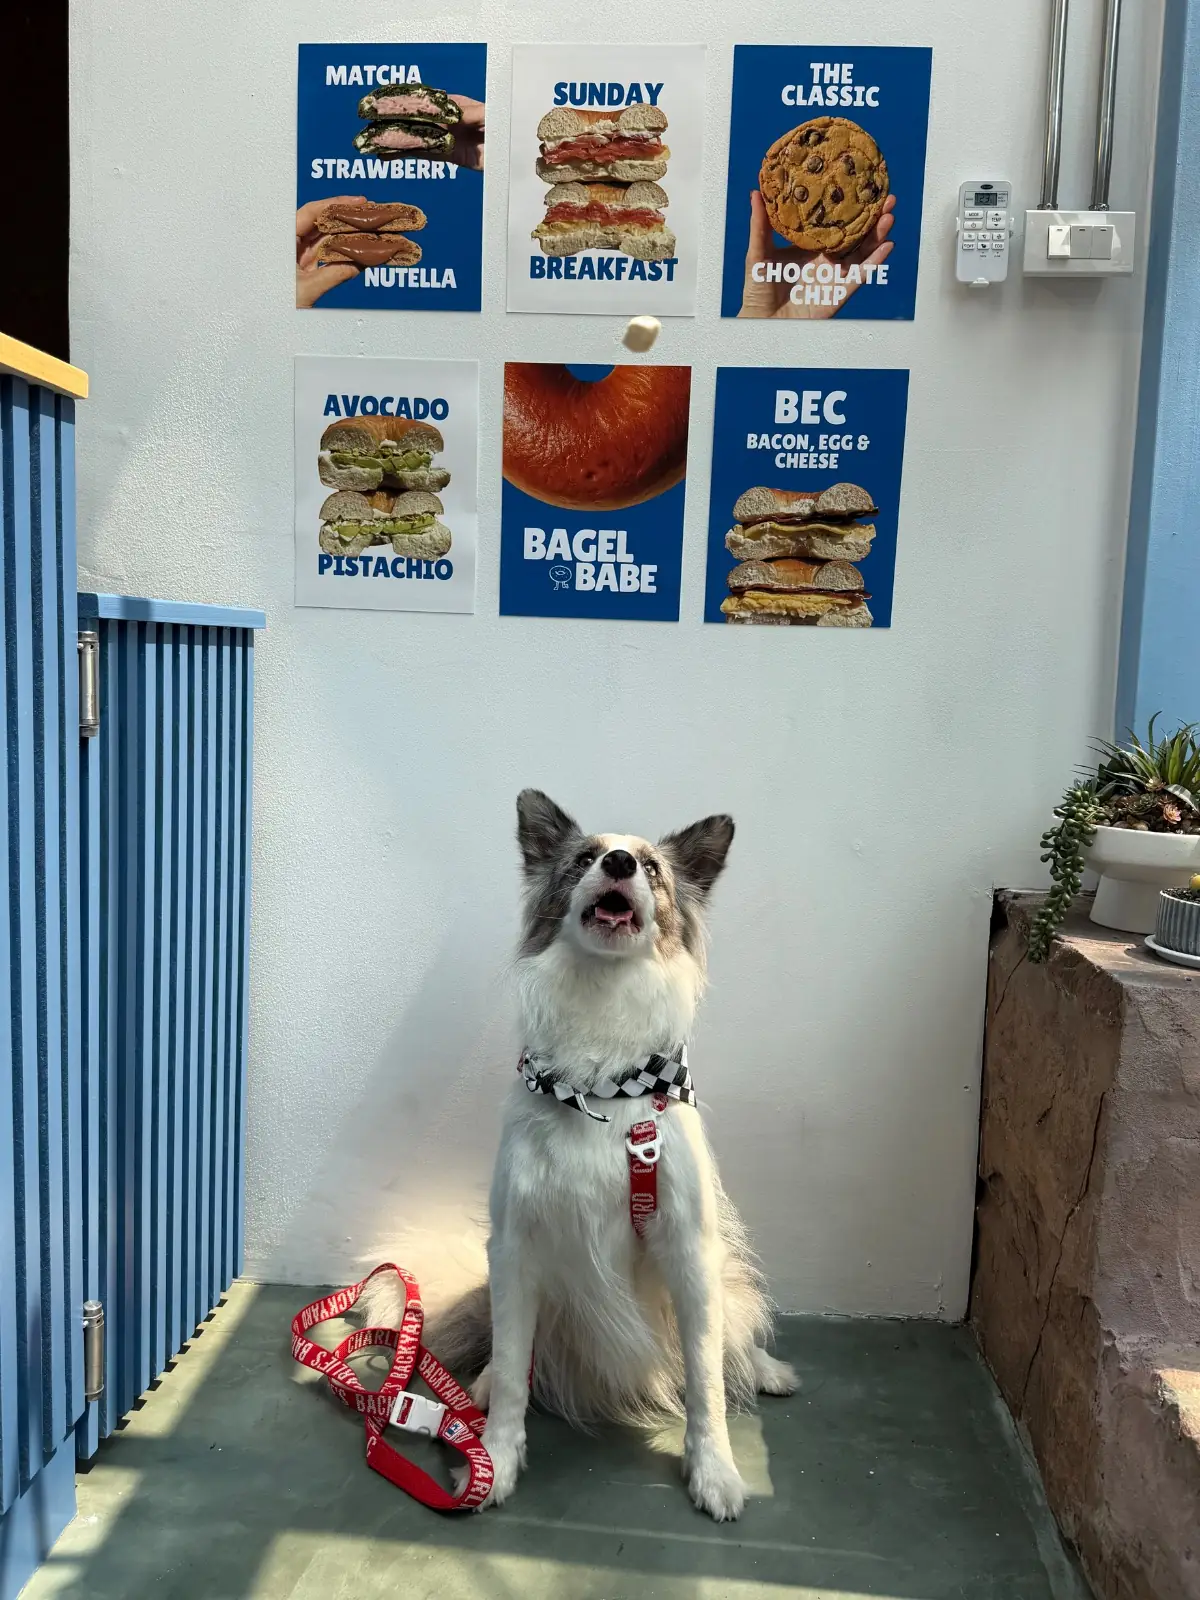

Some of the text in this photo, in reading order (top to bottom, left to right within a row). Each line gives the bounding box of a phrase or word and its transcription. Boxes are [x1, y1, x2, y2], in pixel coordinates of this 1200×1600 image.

[325, 64, 422, 86] MATCHA
[809, 62, 854, 85] THE
[552, 81, 665, 106] SUNDAY
[781, 85, 880, 108] CLASSIC
[310, 158, 459, 180] STRAWBERRY
[364, 267, 458, 289] NUTELLA
[529, 255, 679, 282] BREAKFAST
[751, 262, 889, 286] CHOCOLATE
[789, 285, 848, 307] CHIP
[323, 394, 450, 421] AVOCADO
[774, 389, 848, 426] BEC
[746, 433, 870, 453] BACON, EGG &
[775, 452, 839, 469] CHEESE
[523, 527, 634, 563] BAGEL
[318, 553, 454, 581] PISTACHIO
[575, 562, 658, 594] BABE
[419, 1352, 473, 1411] BACKYARD
